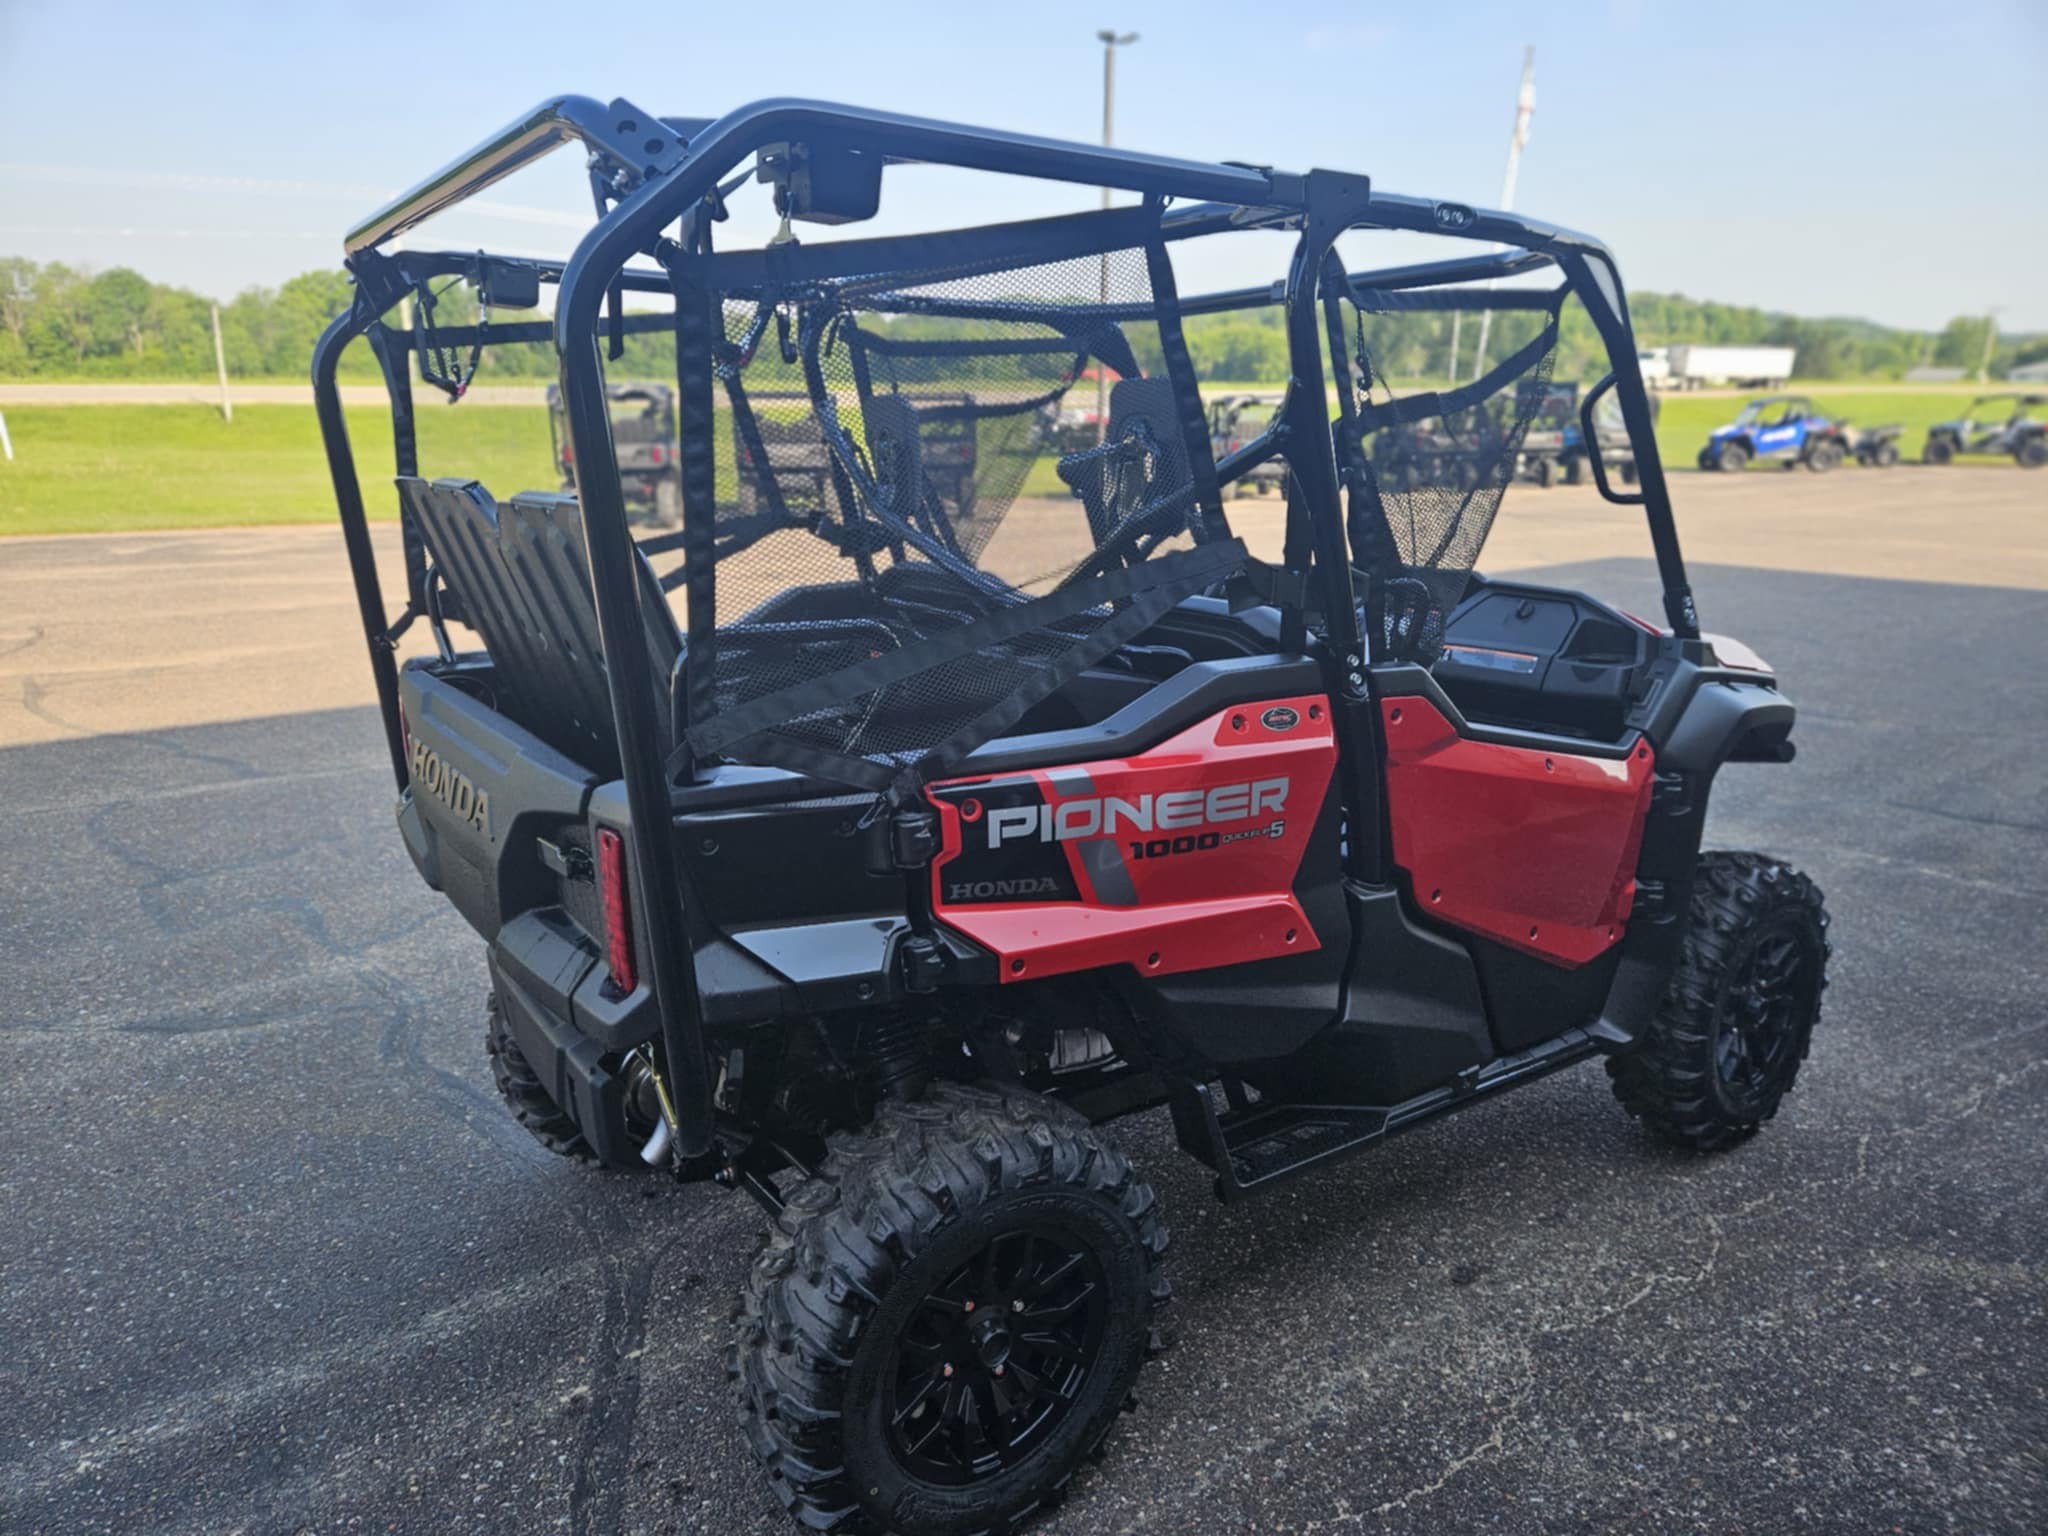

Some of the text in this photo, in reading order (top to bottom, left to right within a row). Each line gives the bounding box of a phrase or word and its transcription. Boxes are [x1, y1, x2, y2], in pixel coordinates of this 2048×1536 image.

[411, 738, 489, 836] HONDA
[987, 776, 1289, 849] PIONEER
[1129, 832, 1219, 860] 1000
[949, 876, 1059, 900] HONDA
